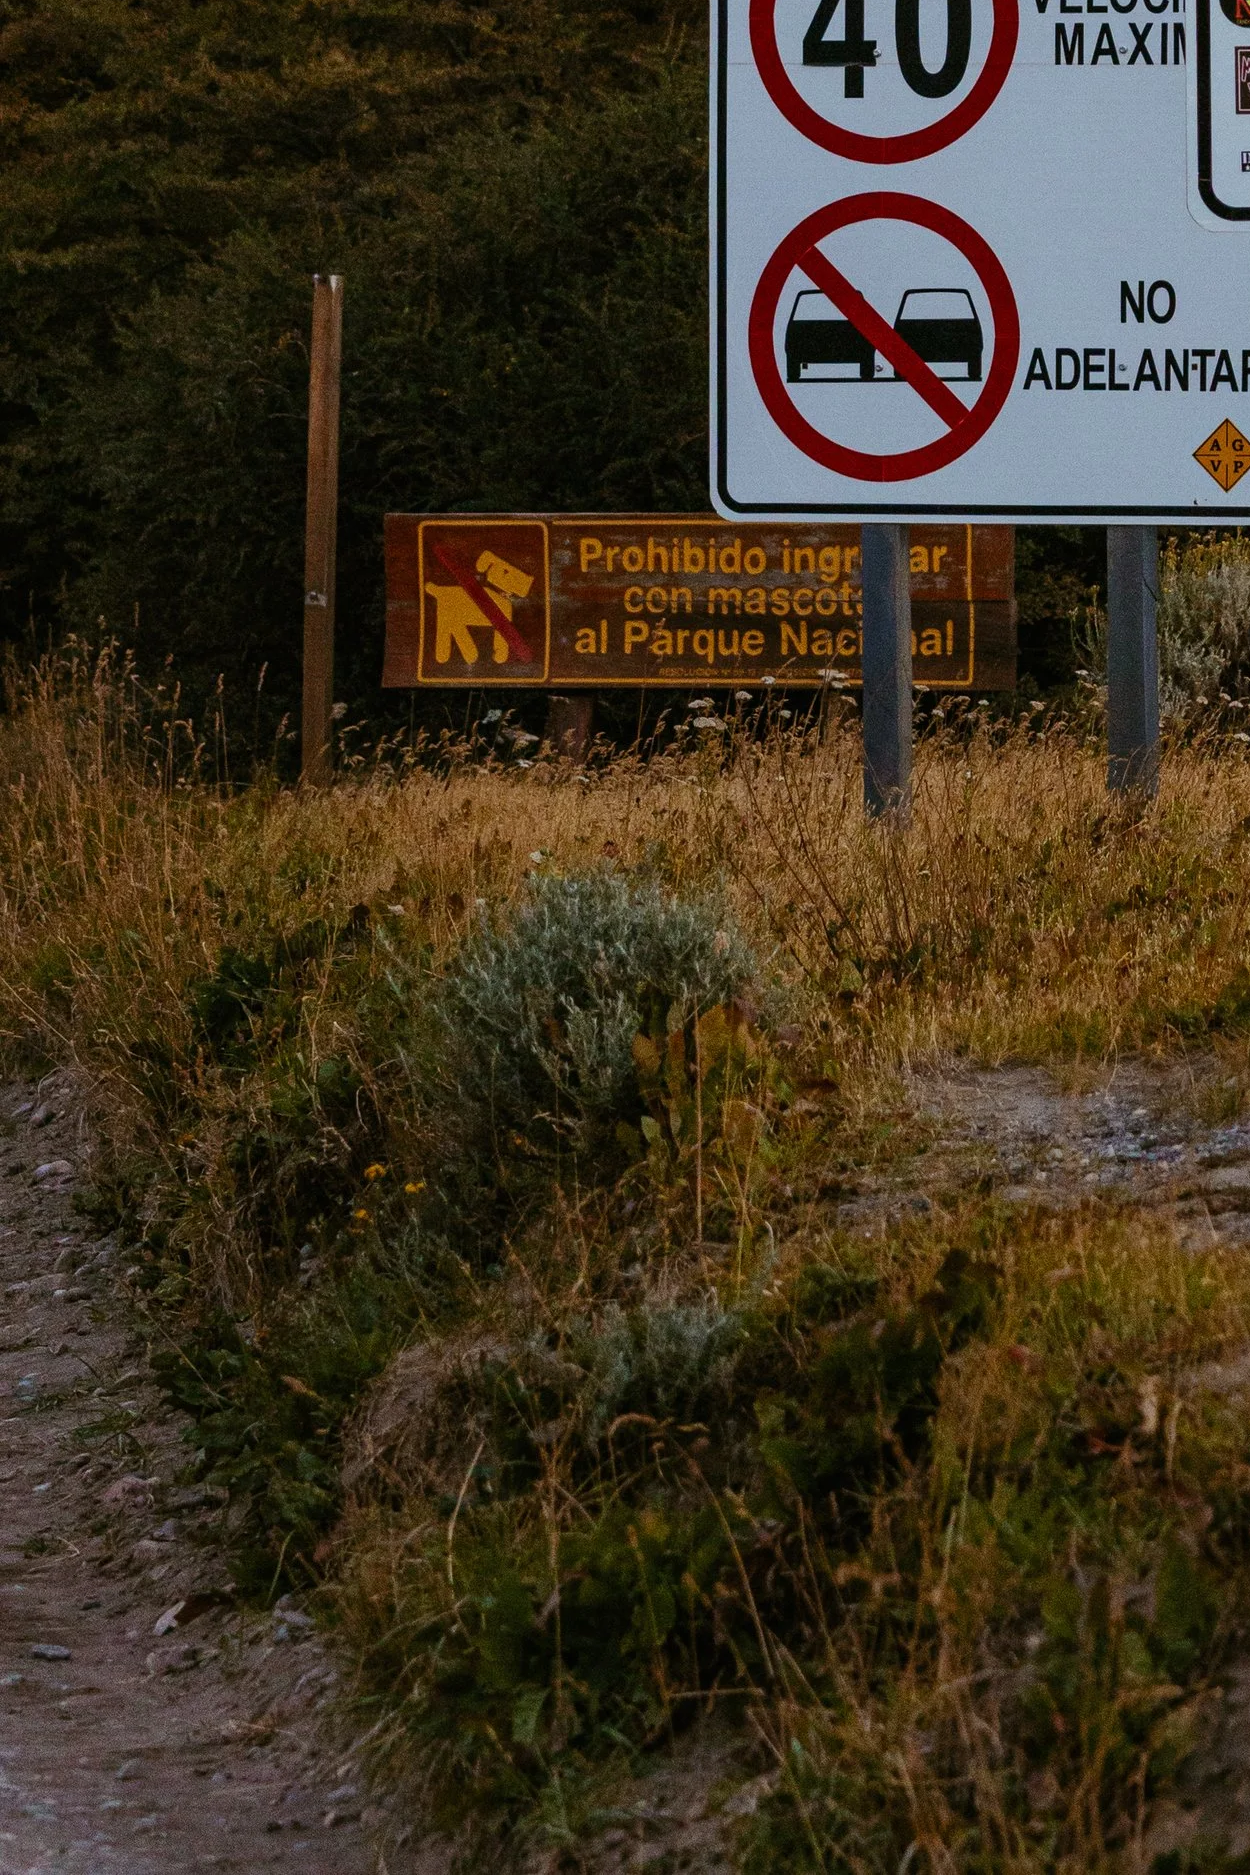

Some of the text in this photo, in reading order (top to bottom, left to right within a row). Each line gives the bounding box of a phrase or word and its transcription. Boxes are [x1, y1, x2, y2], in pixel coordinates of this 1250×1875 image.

[1119, 279, 1177, 324] NO
[579, 536, 949, 583] Prohibido ingrar
[623, 581, 863, 616] con mascot
[574, 618, 608, 655] al
[623, 619, 766, 664] Parque
